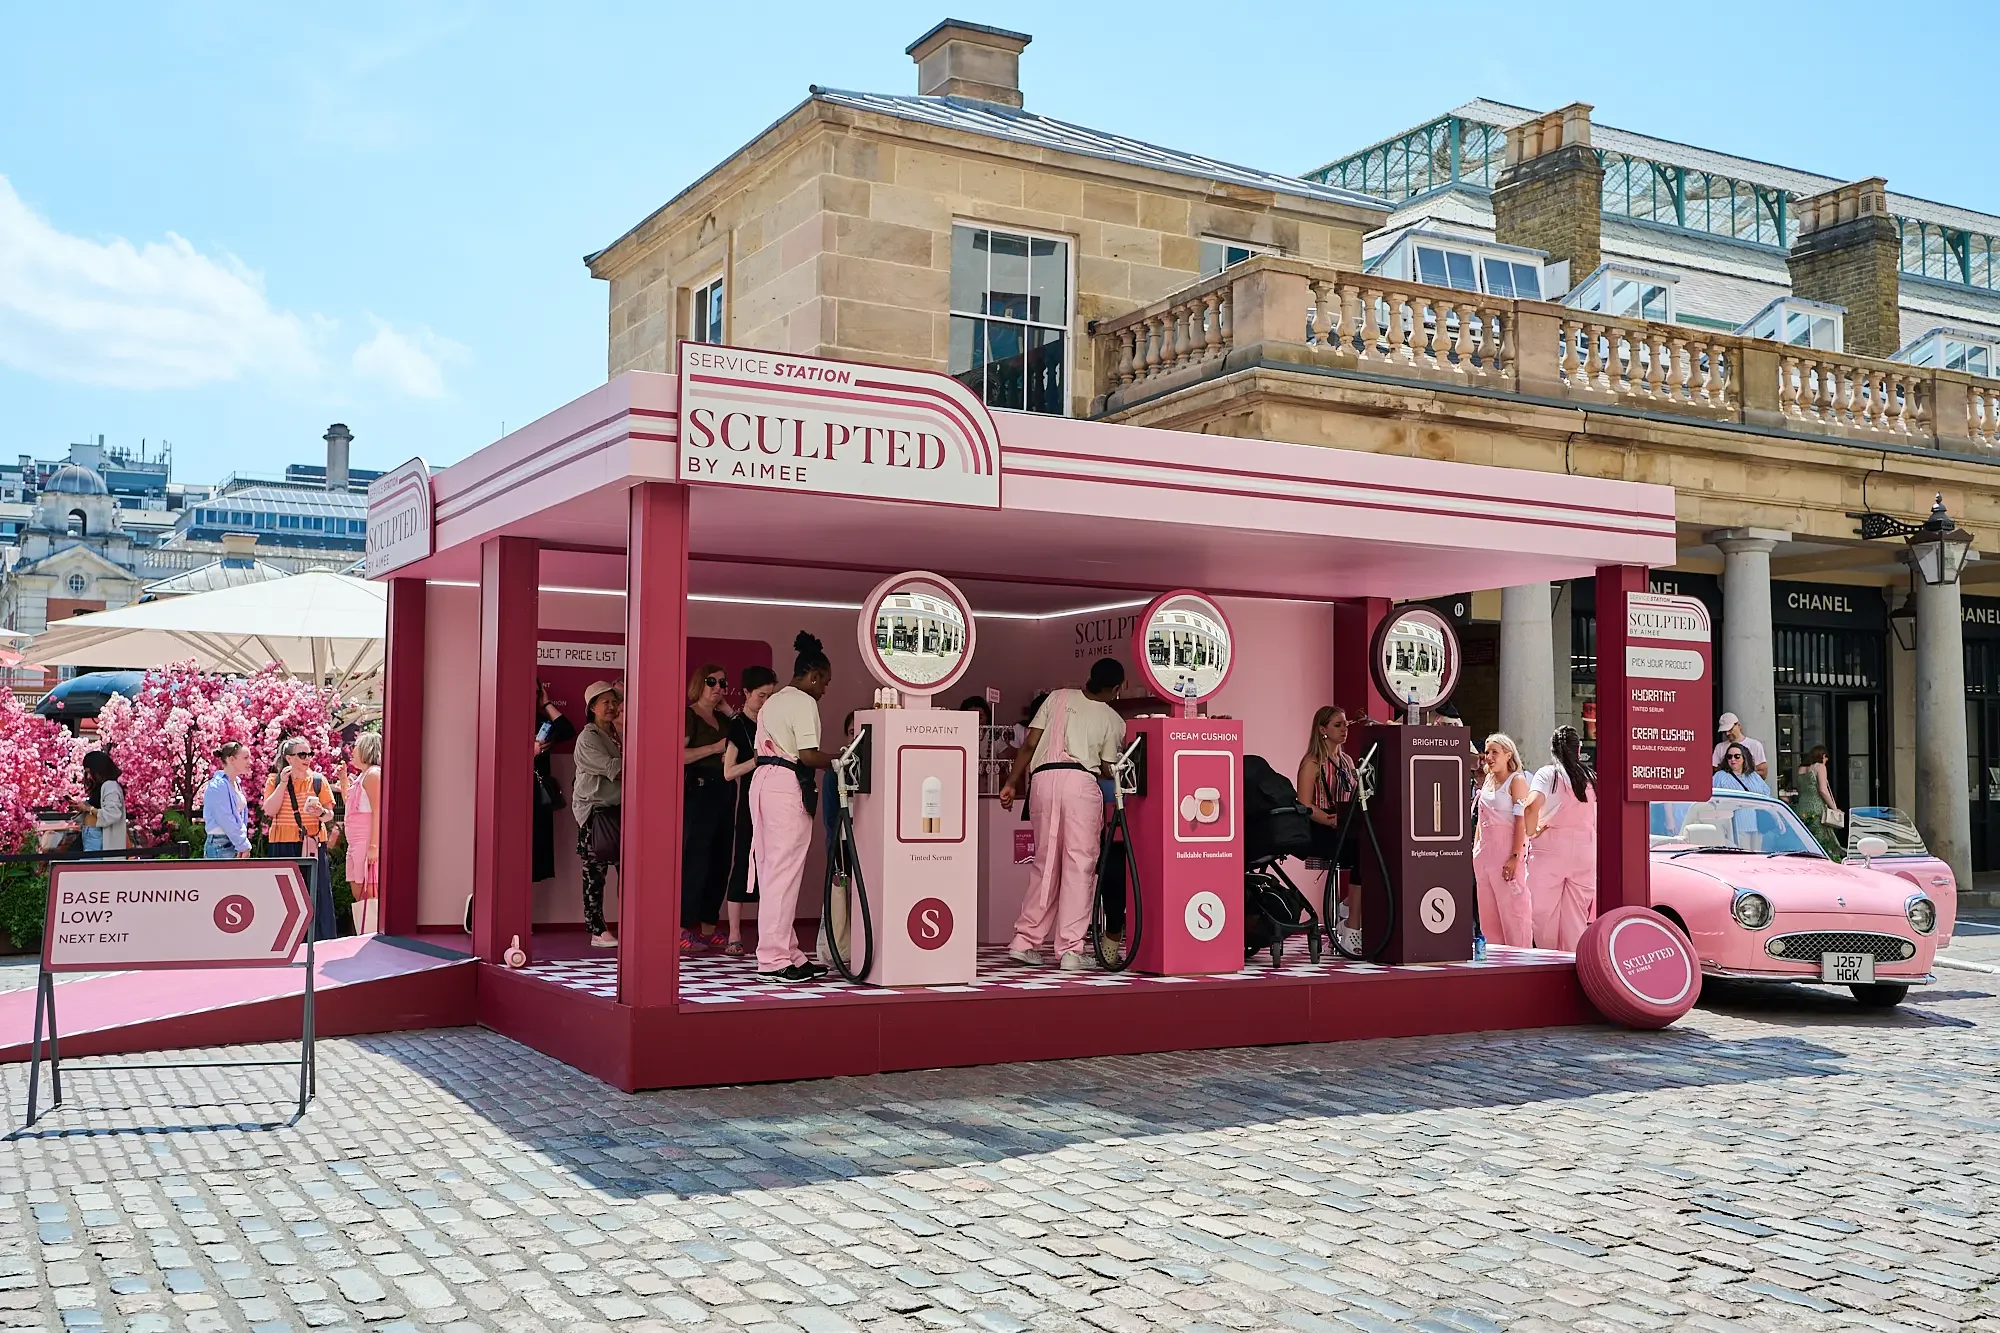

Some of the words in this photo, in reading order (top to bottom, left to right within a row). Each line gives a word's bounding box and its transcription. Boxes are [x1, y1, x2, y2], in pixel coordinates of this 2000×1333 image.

[690, 352, 768, 375] SERVICE
[773, 363, 851, 384] STATION
[689, 408, 946, 470] SCULPTED
[688, 456, 718, 473] BY
[731, 460, 807, 482] AIMEE
[368, 506, 418, 555] SCULPTED
[1787, 592, 1853, 613] CHANEL
[1629, 612, 1696, 631] SCULPTED
[565, 649, 592, 661] PRICE
[596, 651, 617, 661] LIST
[1075, 649, 1084, 658] BY
[1089, 645, 1113, 656] AIMEE
[1631, 658, 1645, 667] PICK
[1647, 659, 1664, 668] YOUR
[1665, 660, 1692, 670] PRODUCT
[1632, 689, 1676, 703] HYDRATINT
[905, 725, 959, 735] HYDRATINT
[1169, 732, 1199, 740] CREAM
[1201, 732, 1238, 741] CUSHION
[1632, 727, 1658, 740] CREAM
[1661, 729, 1694, 741] CUSHION
[1412, 738, 1448, 746] BRIGHTEN
[1450, 739, 1460, 747] UP
[1632, 766, 1671, 779] BRIGHTEN
[1673, 767, 1685, 779] UP
[1176, 851, 1202, 859] Buildable
[1411, 850, 1439, 858] Brightening
[62, 891, 110, 904] BASE
[116, 889, 199, 903] RUNNING
[61, 910, 113, 924] LOW?
[225, 903, 242, 925] S
[1197, 903, 1213, 929] S
[1431, 898, 1445, 923] S
[921, 909, 940, 939] S
[59, 933, 95, 944] NEXT
[99, 932, 129, 943] EXIT
[1623, 946, 1675, 970] SCULPTED
[1833, 956, 1862, 968] J267
[1636, 964, 1652, 973] AIMEE
[1837, 969, 1859, 980] HGK
